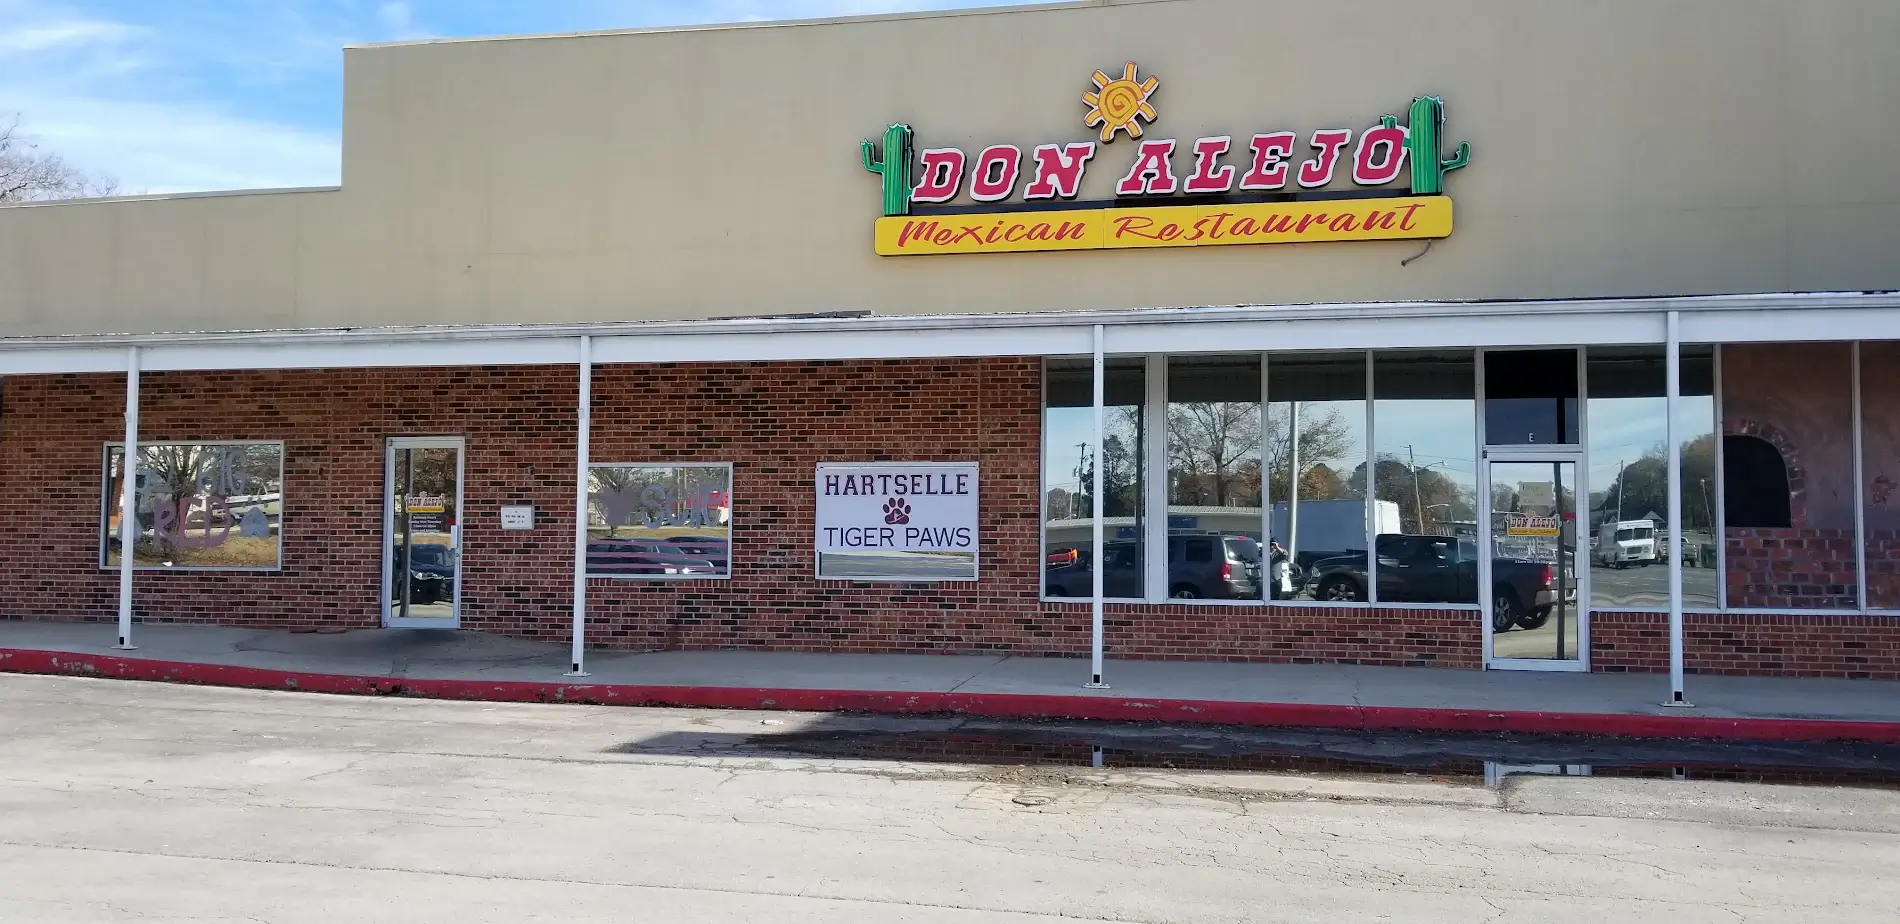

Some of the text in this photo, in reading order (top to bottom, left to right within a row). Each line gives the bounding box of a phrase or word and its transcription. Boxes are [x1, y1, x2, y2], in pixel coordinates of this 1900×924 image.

[910, 126, 1410, 202] DON ALEJO
[898, 203, 1427, 249] Mexican Restaurant
[1528, 432, 1534, 443] E
[196, 449, 248, 496] BIG
[825, 474, 969, 496] HARTSELLE
[153, 495, 234, 549] RED
[824, 527, 971, 547] TIGER PAWS
[1511, 518, 1556, 529] DON ALEJO
